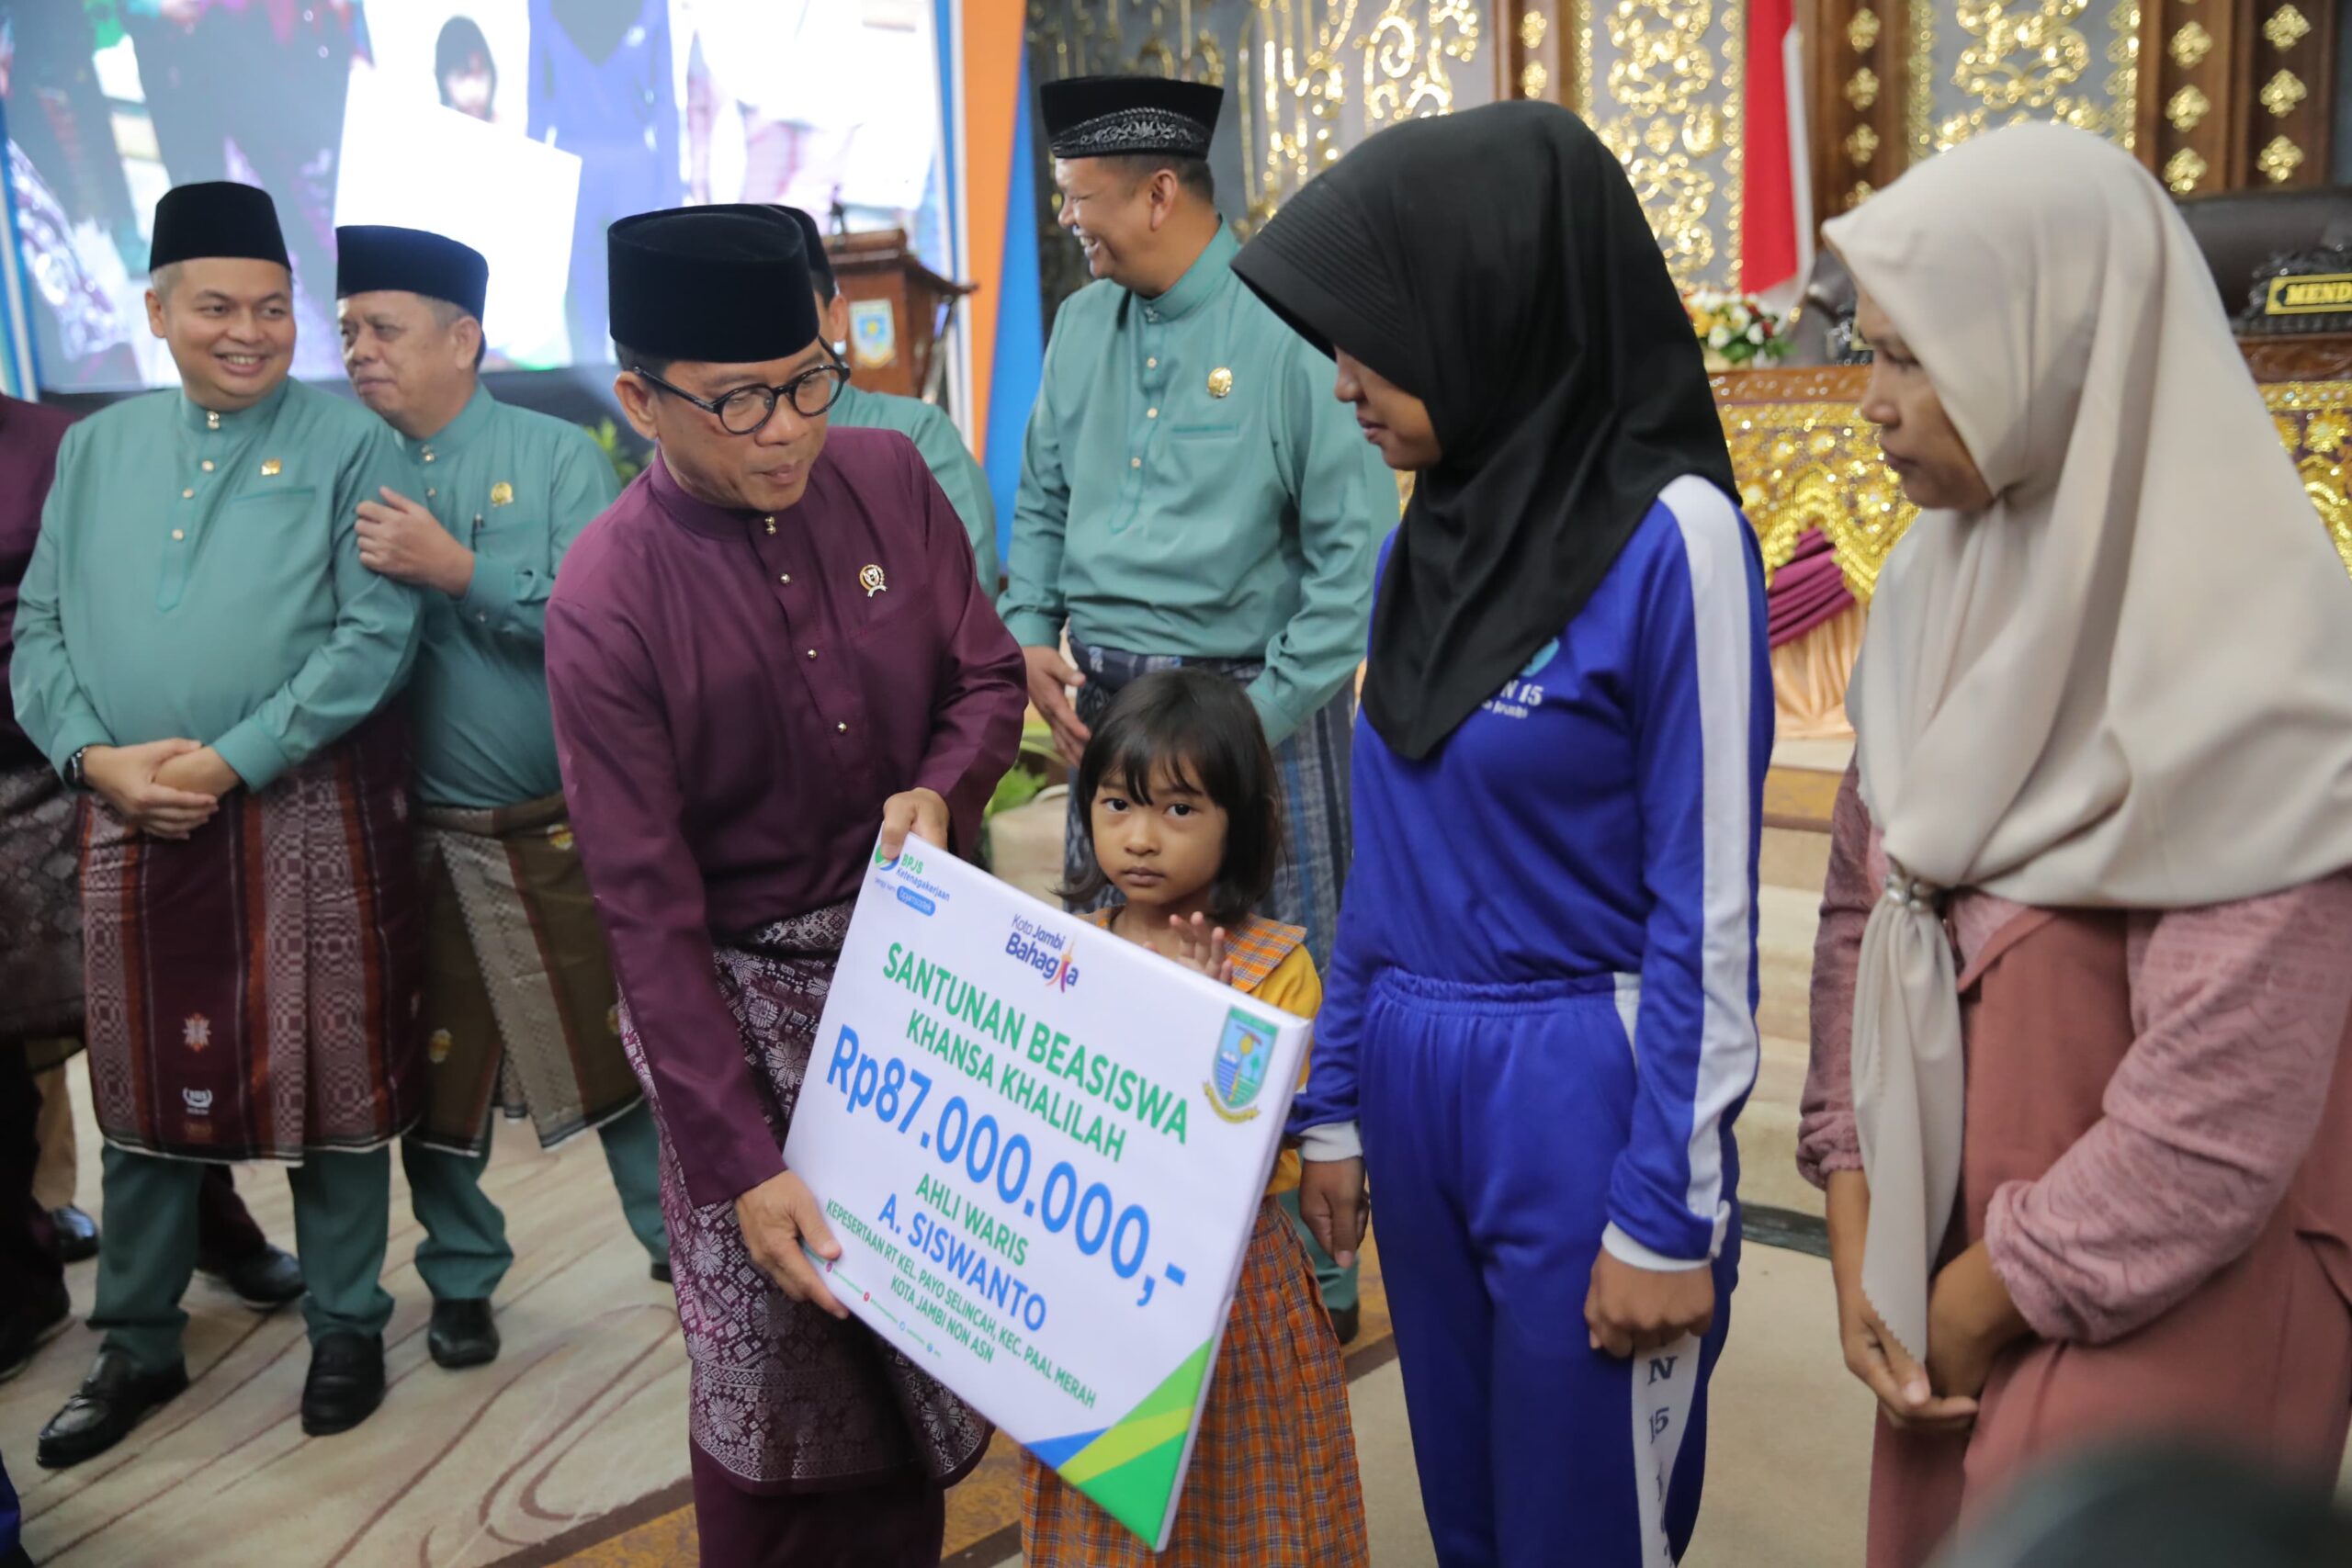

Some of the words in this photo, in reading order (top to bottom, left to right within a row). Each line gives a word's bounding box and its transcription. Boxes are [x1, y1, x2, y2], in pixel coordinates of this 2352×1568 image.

[1519, 682, 1544, 707] 15
[901, 852, 924, 874] BPJS
[1033, 924, 1067, 952] Jambi
[883, 942, 1026, 1051] SANTUNAN
[1026, 1021, 1188, 1145] BEASISWA
[906, 1009, 995, 1088] KHANSA
[999, 1063, 1127, 1163] KHALILAH
[826, 1023, 1188, 1309] Rp87.000.000,-
[877, 1192, 902, 1235] A.
[906, 1211, 1047, 1333] SISWANTO
[915, 1172, 962, 1222] AHLI
[964, 1206, 1030, 1267] WARIS
[825, 1198, 886, 1256] KEPESERTAAN
[883, 1244, 899, 1265] RT
[896, 1252, 917, 1281] KEL.
[918, 1268, 946, 1300] PAYO
[944, 1287, 997, 1341] SELINCAH,
[998, 1325, 1023, 1358] KEC.
[1023, 1344, 1053, 1380] PAAL
[1054, 1366, 1097, 1409] MERAH
[890, 1274, 916, 1307] KOTA
[915, 1295, 948, 1329] JAMBI
[946, 1317, 971, 1346] NON
[969, 1336, 995, 1364] ASN
[1646, 1355, 1679, 1386] N
